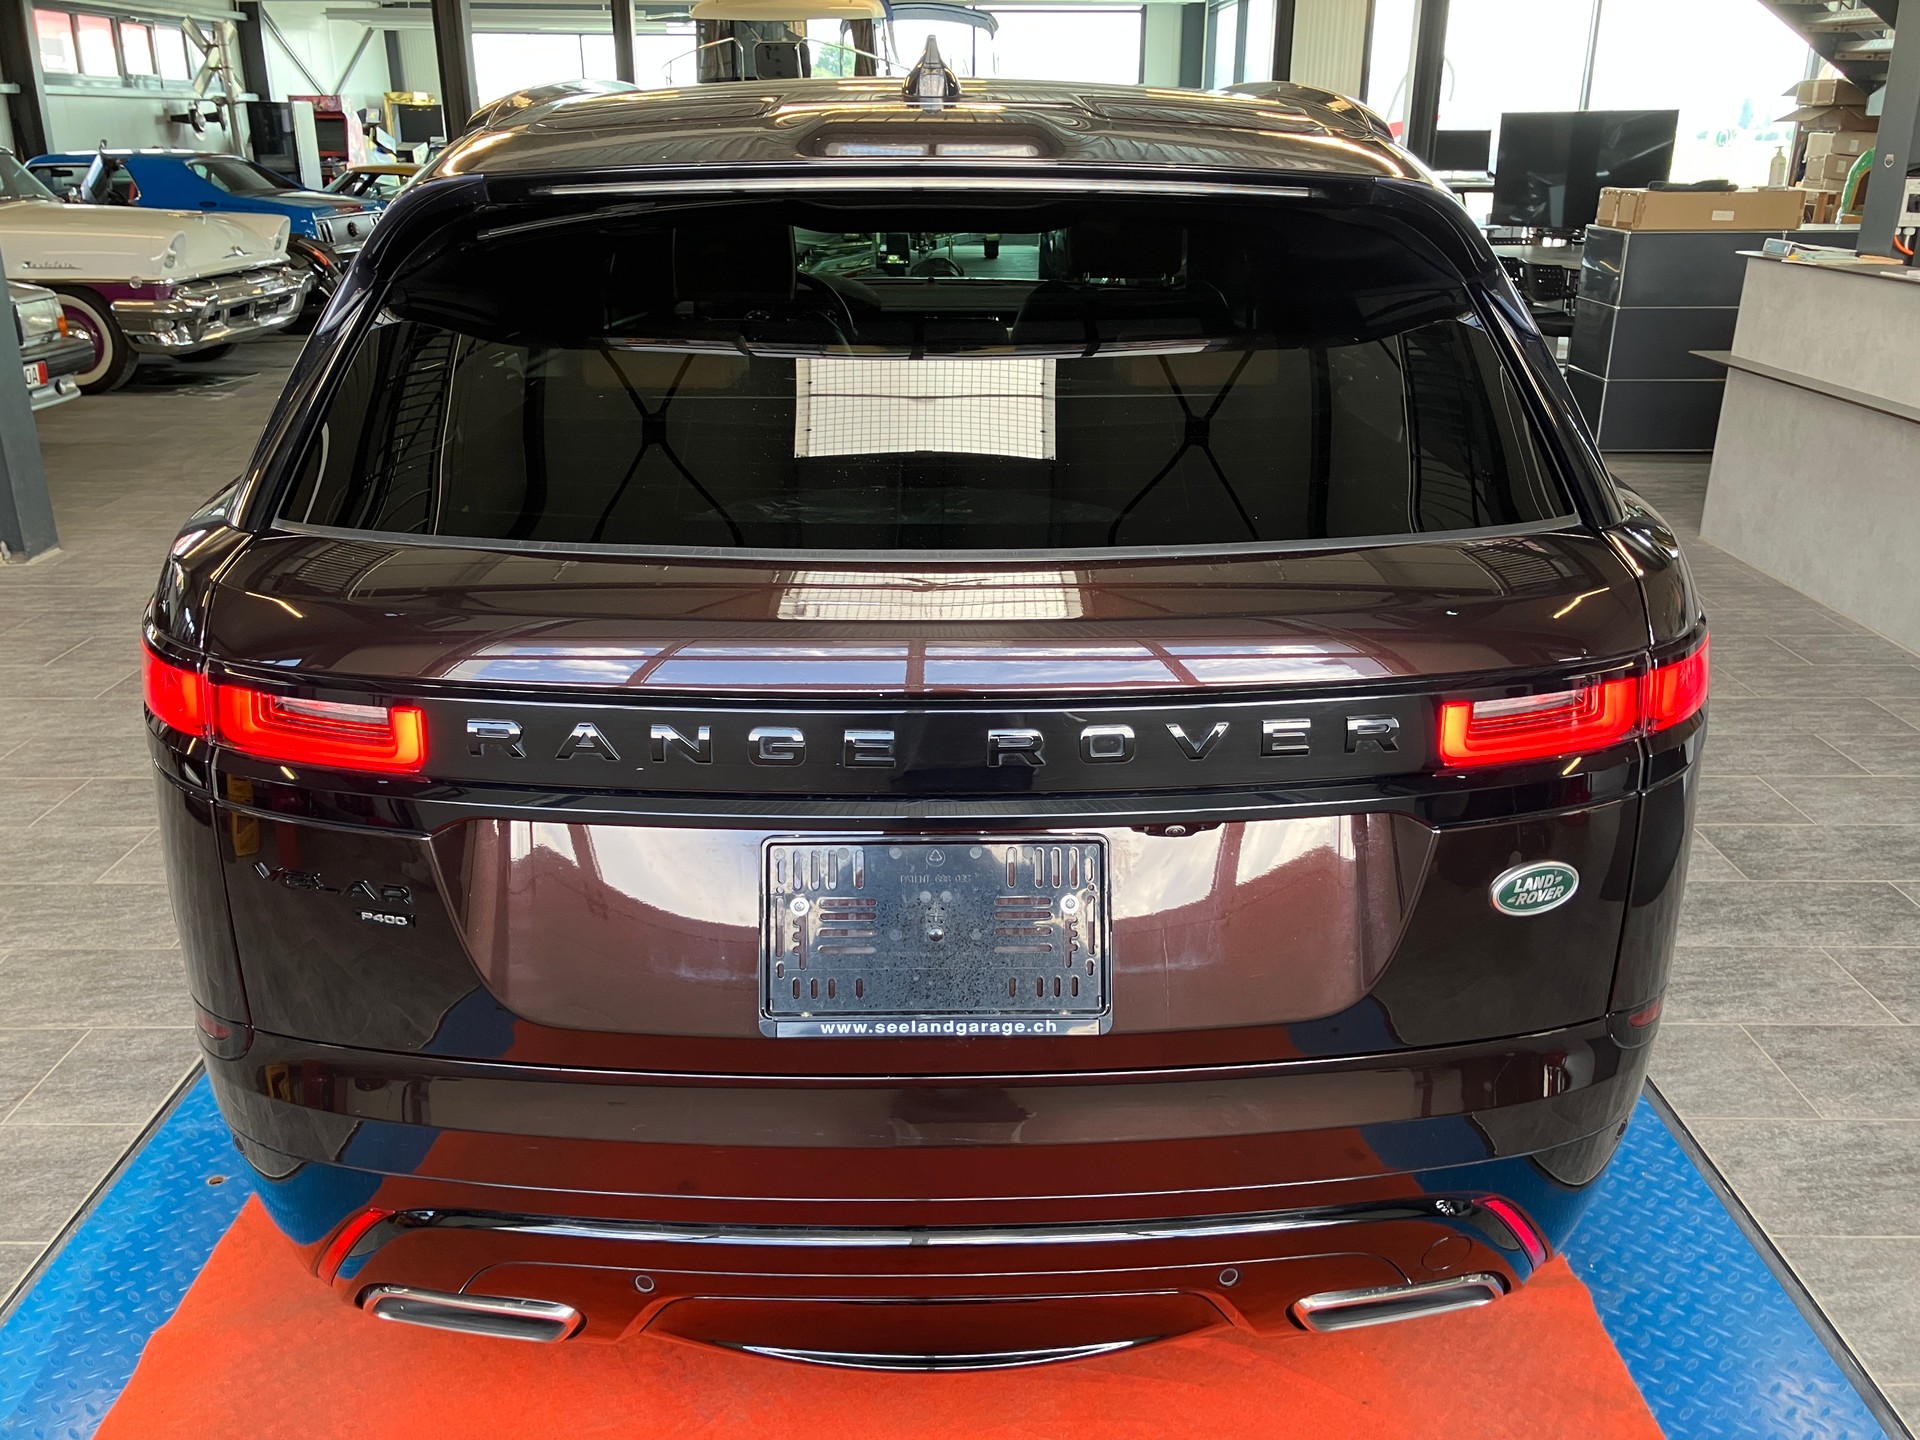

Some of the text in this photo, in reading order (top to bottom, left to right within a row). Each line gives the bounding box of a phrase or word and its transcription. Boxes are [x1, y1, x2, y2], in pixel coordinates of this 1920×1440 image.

[466, 714, 1400, 768] RANGE ROVER
[1513, 874, 1555, 893] LAND
[1514, 885, 1564, 906] ROVER
[360, 911, 408, 926] P400
[820, 1019, 1058, 1036] www.seelandgarage.ch
